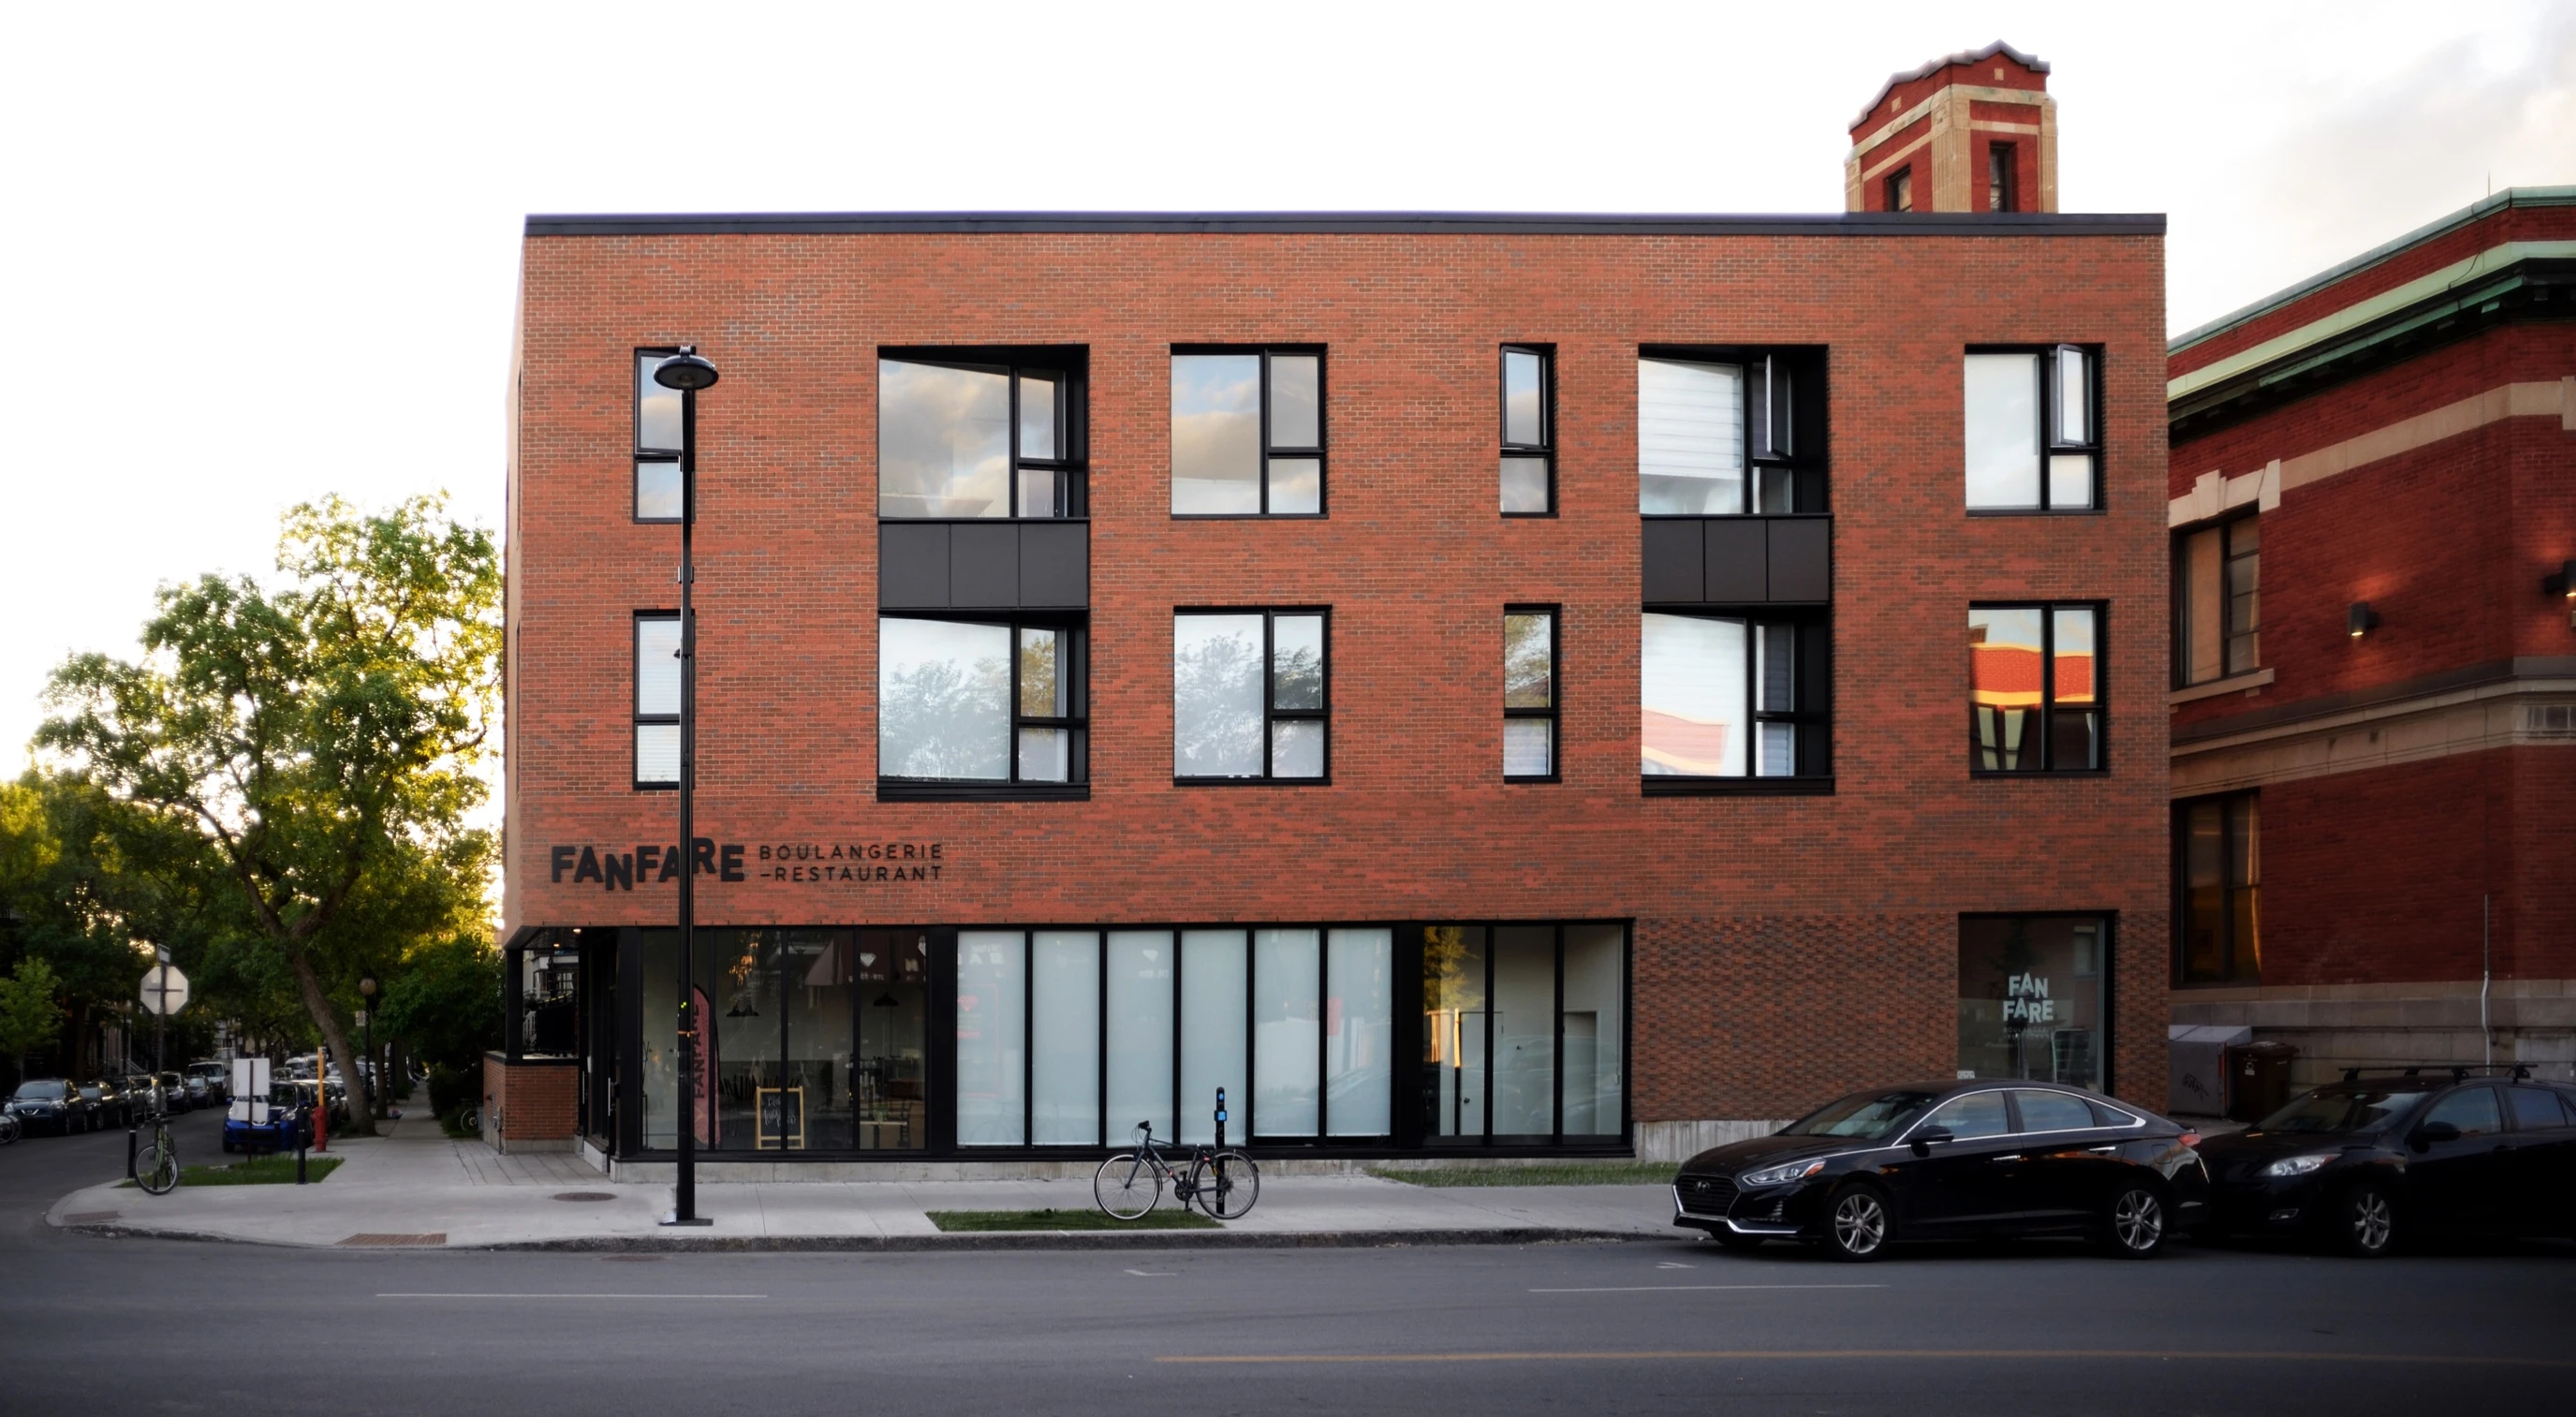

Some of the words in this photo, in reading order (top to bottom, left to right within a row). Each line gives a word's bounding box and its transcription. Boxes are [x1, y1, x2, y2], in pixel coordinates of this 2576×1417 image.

[552, 837, 745, 891] FANFARE
[759, 844, 943, 860] BOULANGERIE
[2009, 972, 2049, 999] FAN
[2003, 997, 2054, 1024] FARE
[694, 1004, 705, 1099] FANFA
